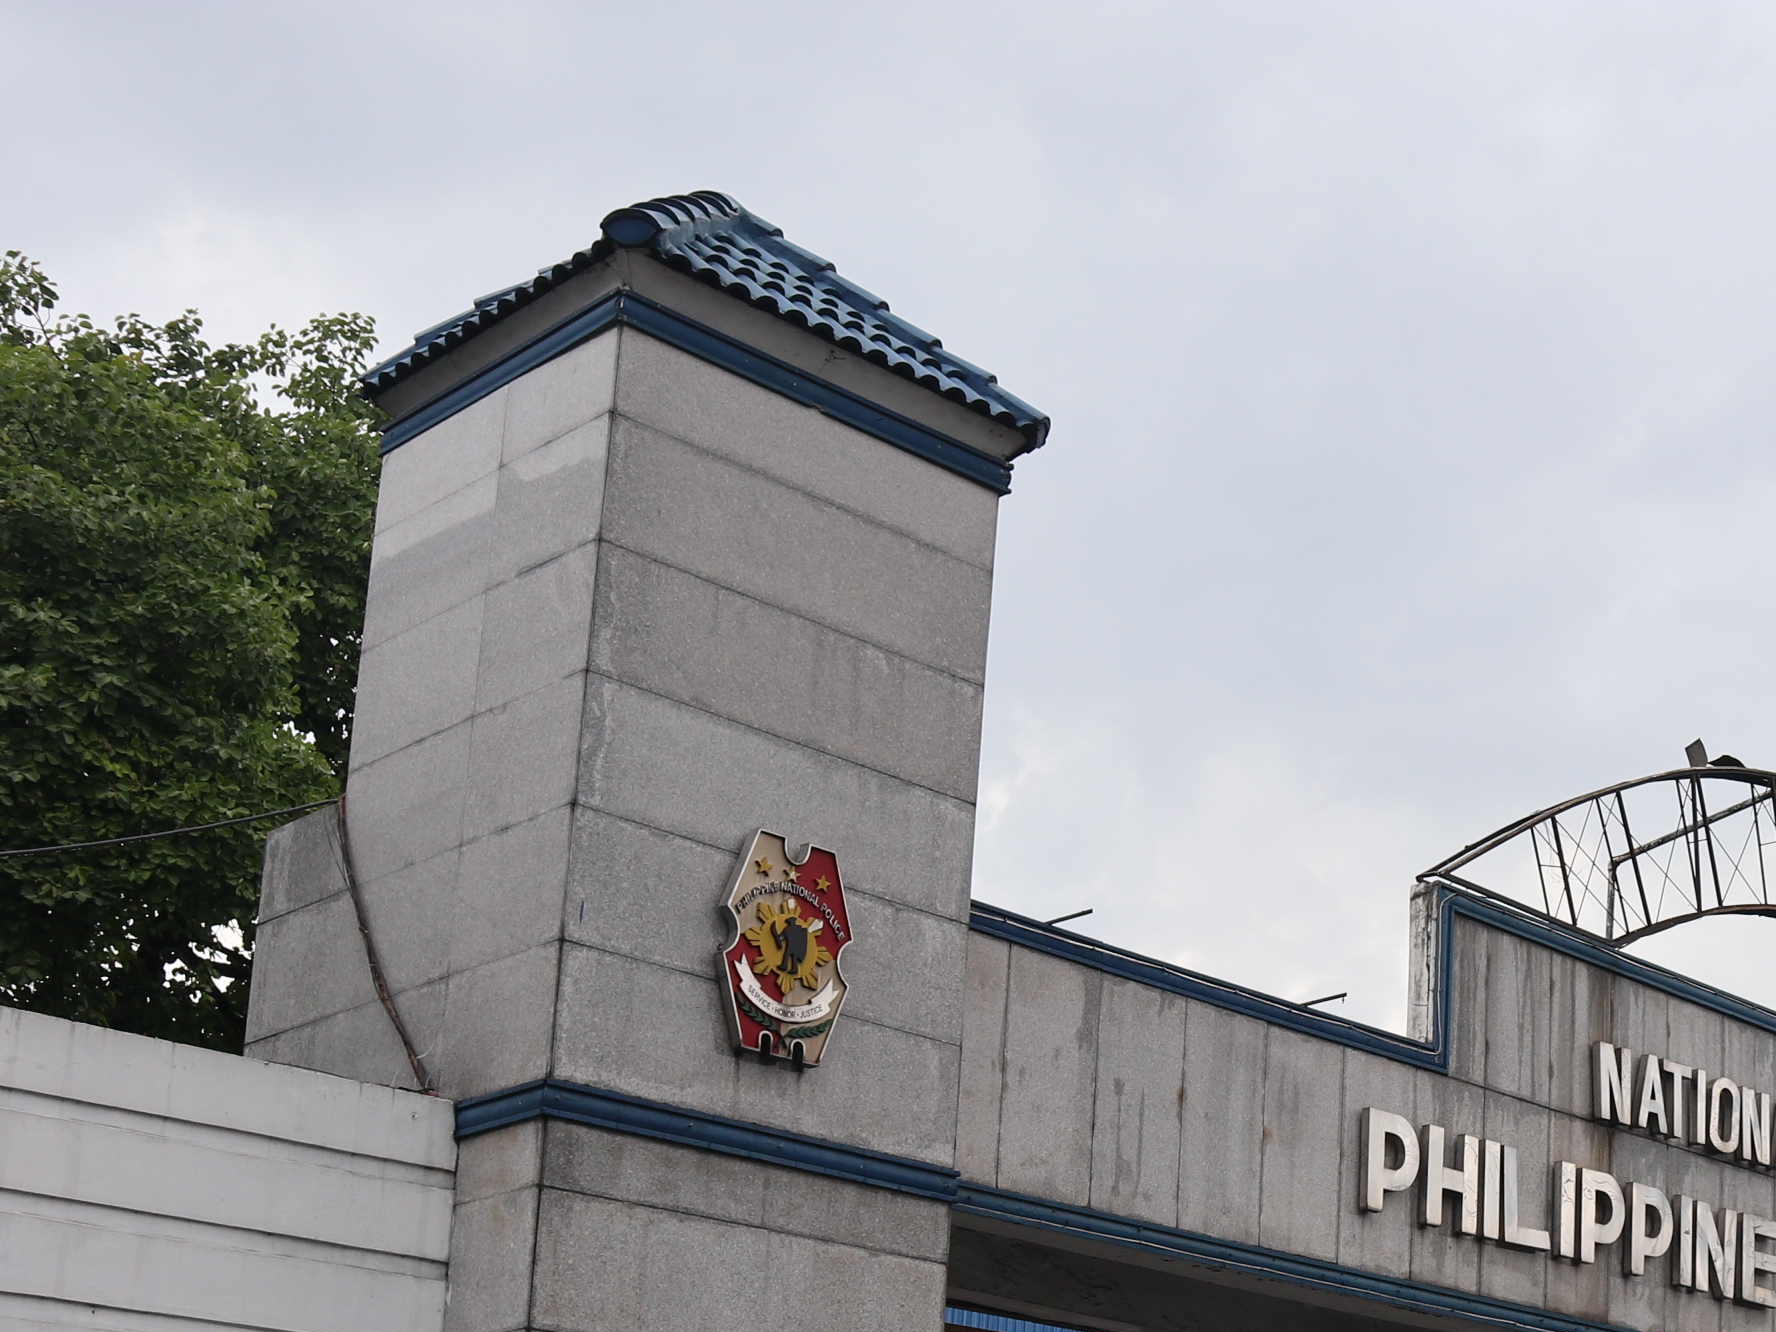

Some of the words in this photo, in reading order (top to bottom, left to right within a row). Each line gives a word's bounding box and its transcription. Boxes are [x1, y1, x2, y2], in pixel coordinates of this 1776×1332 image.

[736, 882, 781, 915] PHILIPPINE
[780, 881, 820, 909] NATIONAL
[821, 902, 846, 941] POLICE
[747, 984, 772, 1011] SERVICE
[774, 1006, 797, 1018] HONOR
[799, 1003, 823, 1019] JUSTICE
